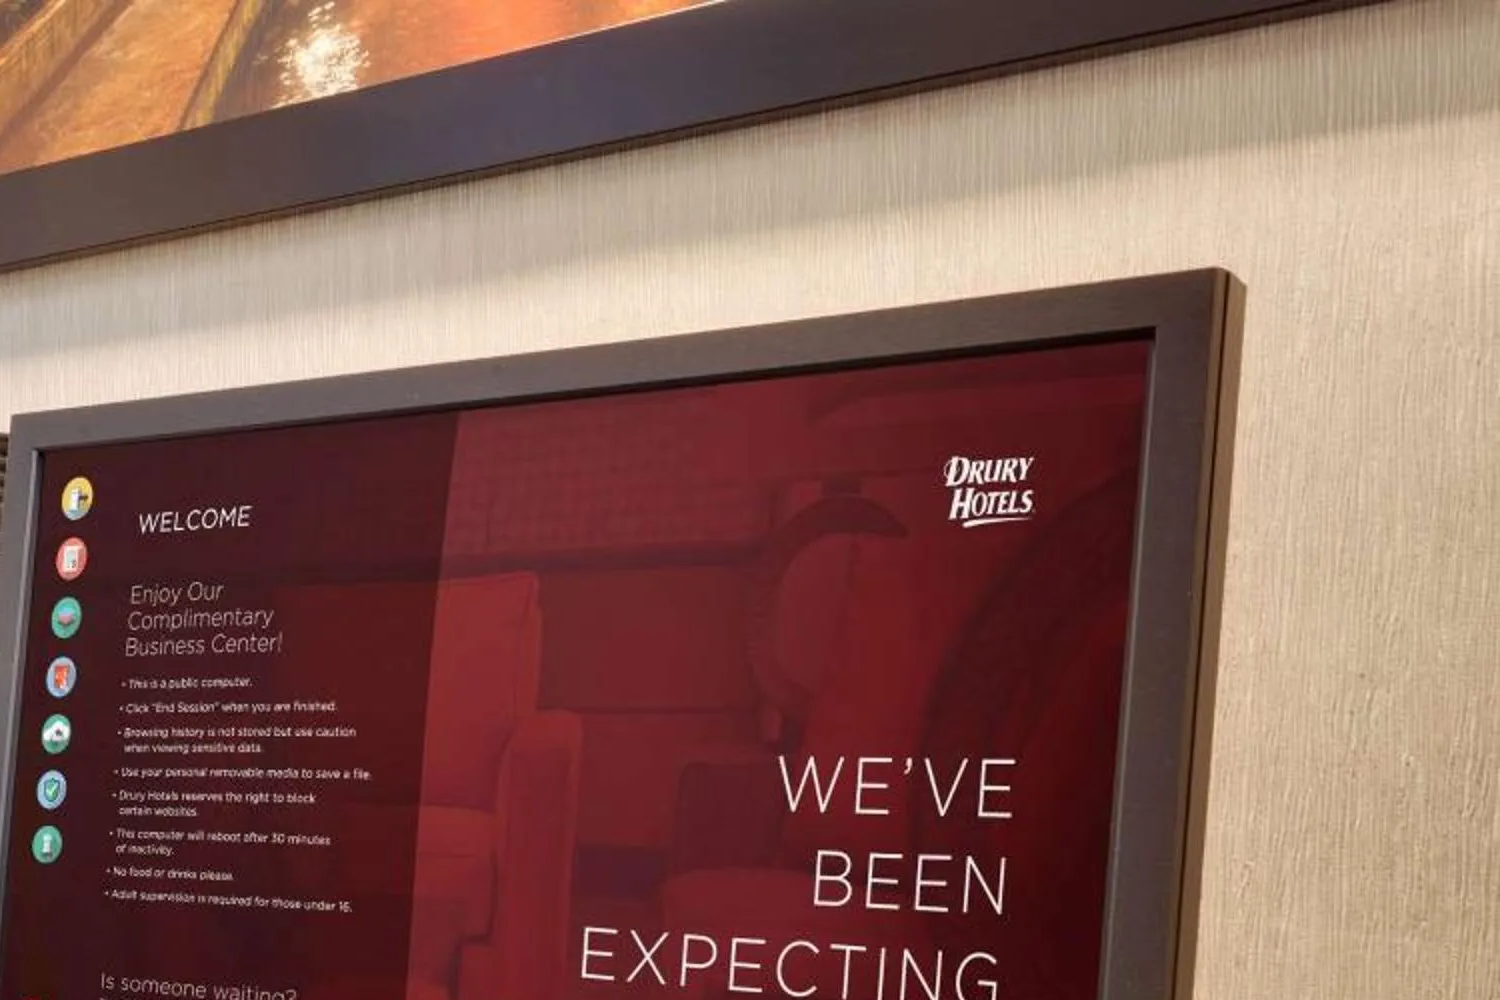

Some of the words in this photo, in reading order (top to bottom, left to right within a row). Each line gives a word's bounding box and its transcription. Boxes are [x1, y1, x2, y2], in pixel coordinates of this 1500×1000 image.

[139, 505, 253, 534] WELCOME
[130, 582, 181, 609] Enjoy
[187, 580, 224, 602] Our
[128, 607, 275, 633] Complimentary
[125, 636, 205, 657] Business
[211, 632, 283, 655] Center!
[129, 679, 148, 689] This
[149, 678, 158, 688] is
[159, 680, 167, 688] a
[168, 677, 199, 690] public
[201, 675, 253, 689] computer.
[125, 703, 149, 713] Click
[221, 701, 249, 712] when
[251, 702, 271, 714] you
[274, 702, 291, 712] are
[293, 700, 338, 712] finished.
[123, 727, 169, 739] Browsing
[171, 727, 204, 739] history
[207, 727, 216, 737] is
[217, 727, 235, 737] not
[237, 726, 271, 737] stored
[273, 727, 292, 737] but
[295, 729, 313, 737] use
[316, 726, 357, 737] caution
[124, 743, 150, 753] when
[152, 743, 189, 755] viewing
[191, 742, 235, 753] sensitive
[121, 767, 139, 777] Use
[141, 768, 163, 779] your
[165, 767, 208, 779] personal
[209, 767, 264, 779] removable
[266, 767, 299, 779] media
[301, 768, 312, 779] to
[315, 770, 341, 779] save
[343, 770, 351, 779] a
[778, 755, 1016, 819] WE’VE
[119, 790, 146, 802] Drury
[147, 791, 179, 802] Hotels
[181, 792, 223, 802] reserves
[225, 792, 242, 803] the
[245, 792, 269, 805] right
[272, 793, 284, 804] to
[287, 793, 316, 804] block
[119, 806, 152, 816] certain
[116, 828, 135, 839] This
[137, 831, 184, 841] computer
[187, 830, 204, 841] will
[207, 831, 241, 842] reboot
[243, 832, 268, 843] after
[271, 833, 285, 844] 30
[287, 834, 331, 845] minutes
[116, 843, 127, 853] of
[128, 844, 174, 856] inactivity.
[113, 866, 127, 877] No
[129, 866, 152, 877] food
[154, 868, 165, 878] or
[167, 867, 197, 879] drinks
[813, 849, 1007, 915] BEEN
[111, 889, 137, 900] Adult
[140, 891, 195, 903] supervision
[197, 893, 206, 903] is
[207, 894, 253, 906] required
[254, 895, 270, 907] for
[271, 897, 302, 909] those
[303, 900, 336, 911] under
[101, 973, 115, 990] Is
[120, 976, 207, 999] someone
